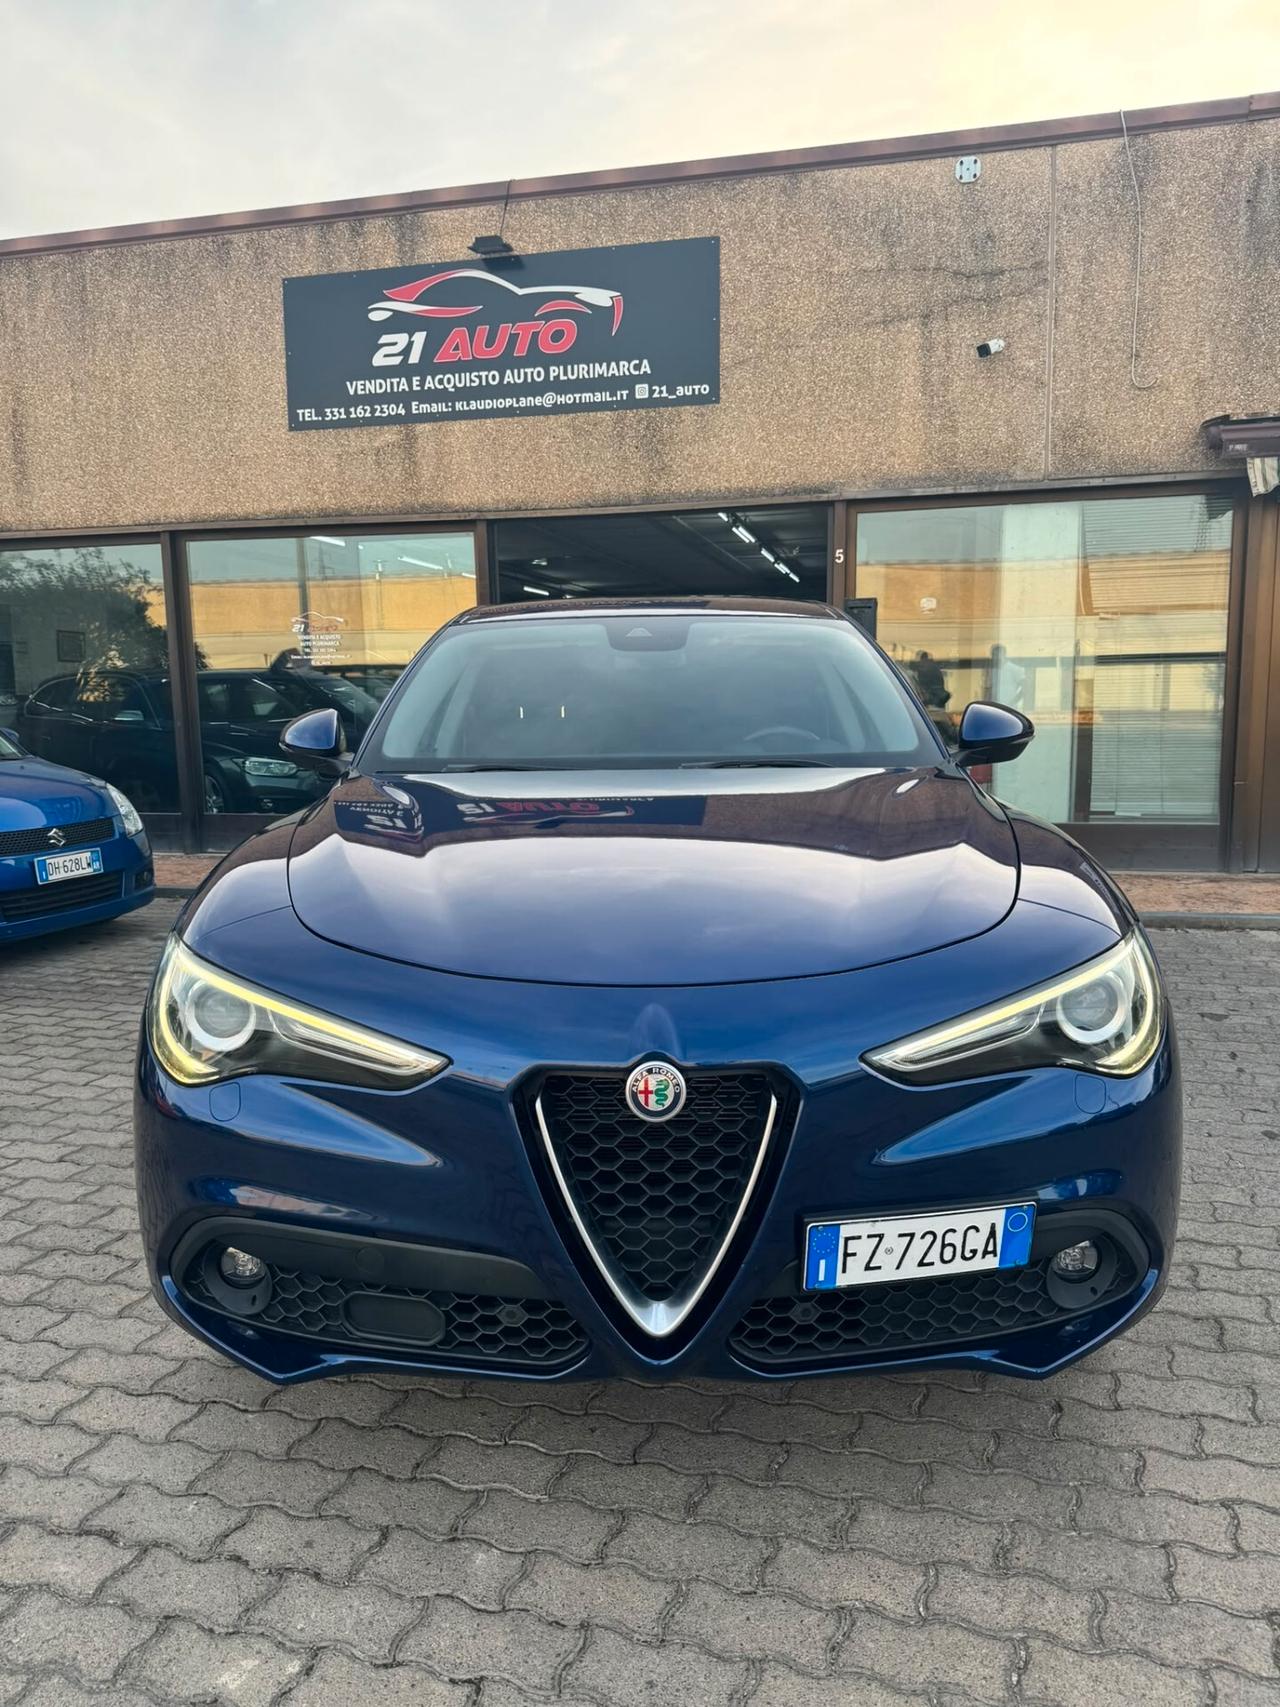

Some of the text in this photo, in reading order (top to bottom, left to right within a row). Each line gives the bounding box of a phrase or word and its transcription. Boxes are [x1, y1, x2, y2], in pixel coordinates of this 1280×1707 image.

[372, 319, 578, 367] 21 AUTO
[346, 359, 652, 395] VENDITA E ACQUISTO AUTO PLURIMARCA
[296, 407, 322, 421] TEL.
[324, 406, 347, 421] 331
[349, 405, 372, 418] 162
[374, 403, 406, 417] 2304
[835, 548, 844, 564] 5
[632, 1067, 680, 1093] ALFA ROMEO
